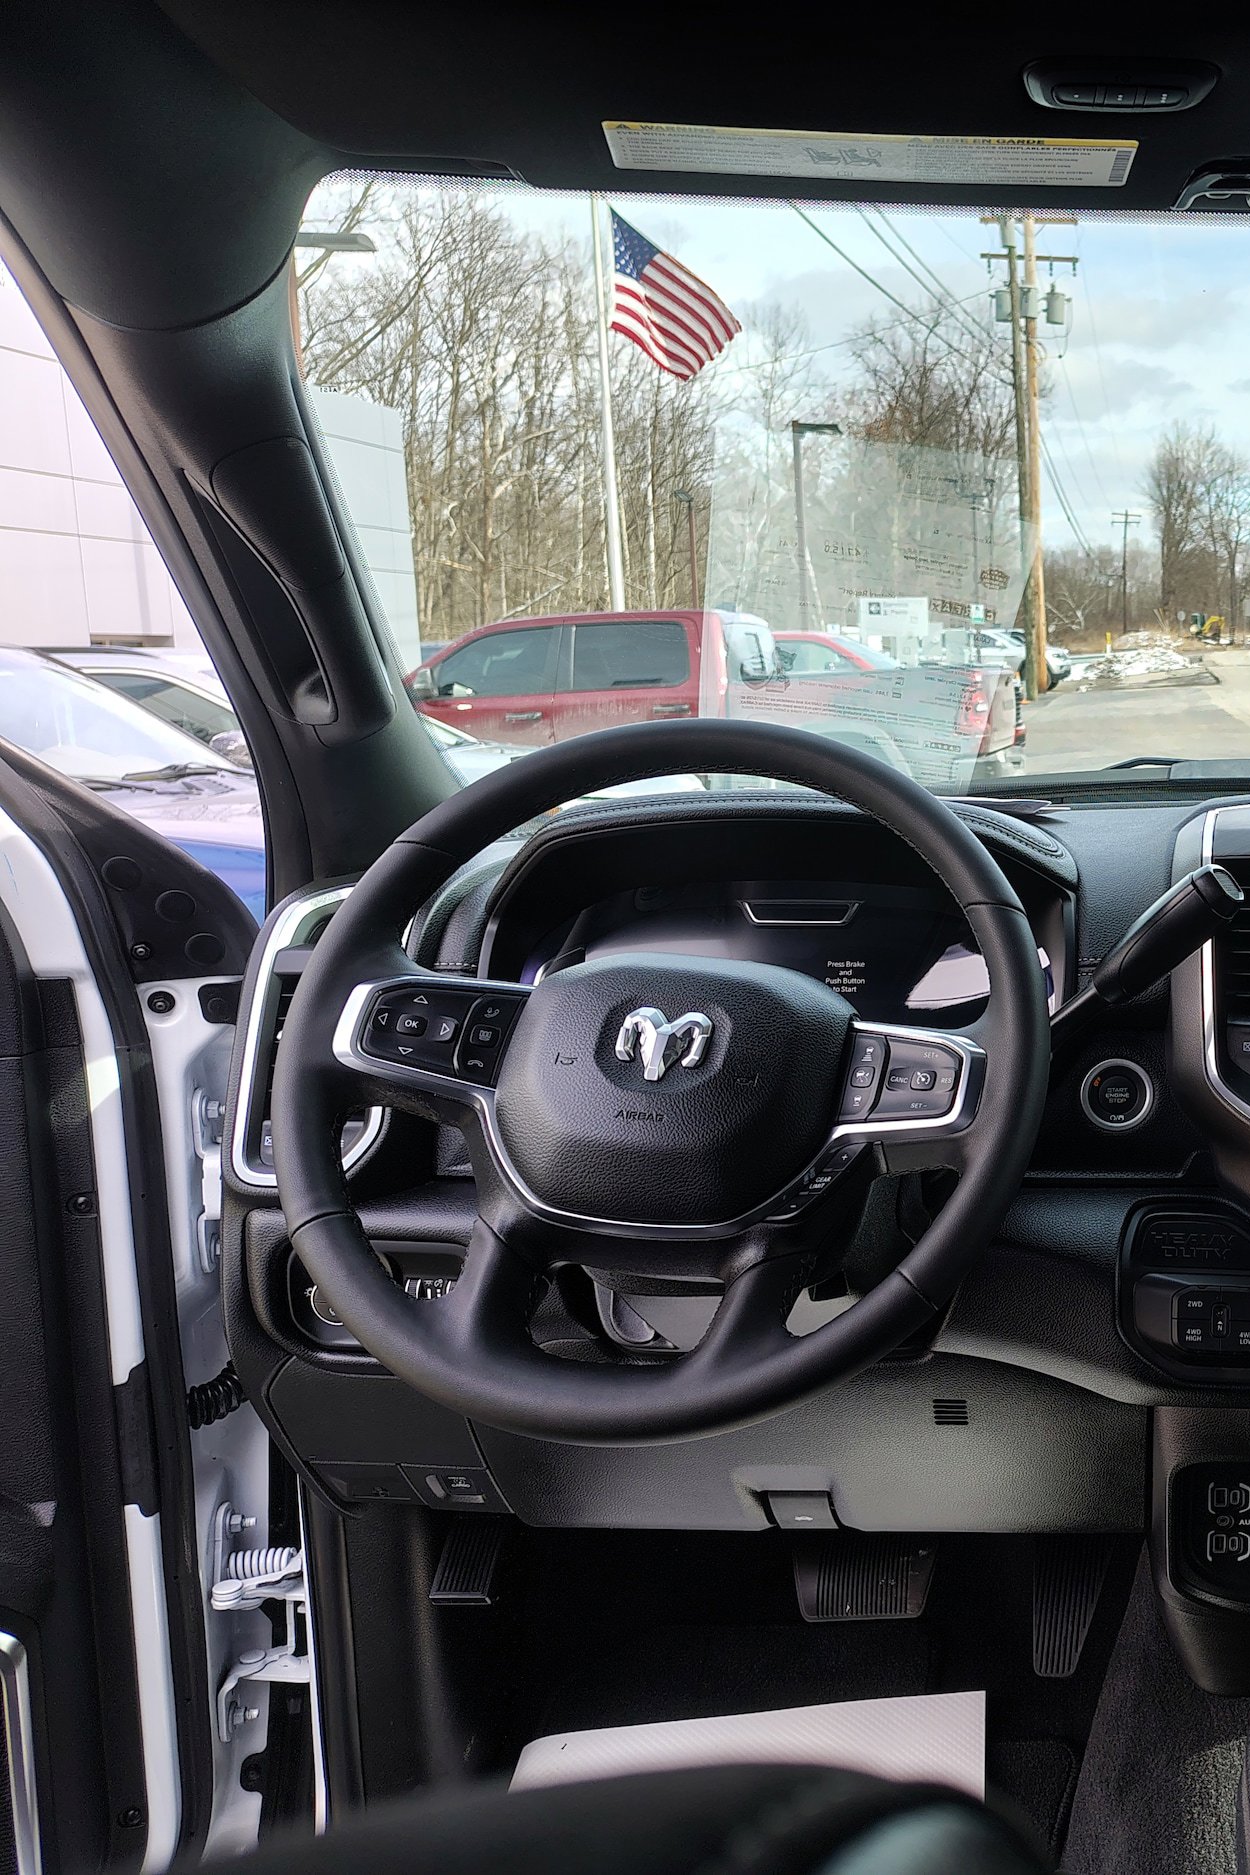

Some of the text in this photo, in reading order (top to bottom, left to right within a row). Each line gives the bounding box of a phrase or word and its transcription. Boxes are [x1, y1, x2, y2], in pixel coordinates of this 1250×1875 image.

[639, 124, 716, 134] WARNING
[827, 960, 866, 968] Press Brake
[404, 1020, 420, 1028] OK
[890, 1076, 908, 1084] CANC
[615, 1110, 665, 1122] AIRBAG
[1150, 1231, 1236, 1246] HEAVY
[1160, 1246, 1233, 1260] DUTY
[1187, 1300, 1204, 1308] 2WD
[1186, 1328, 1202, 1336] 4WD
[1217, 1324, 1223, 1332] N
